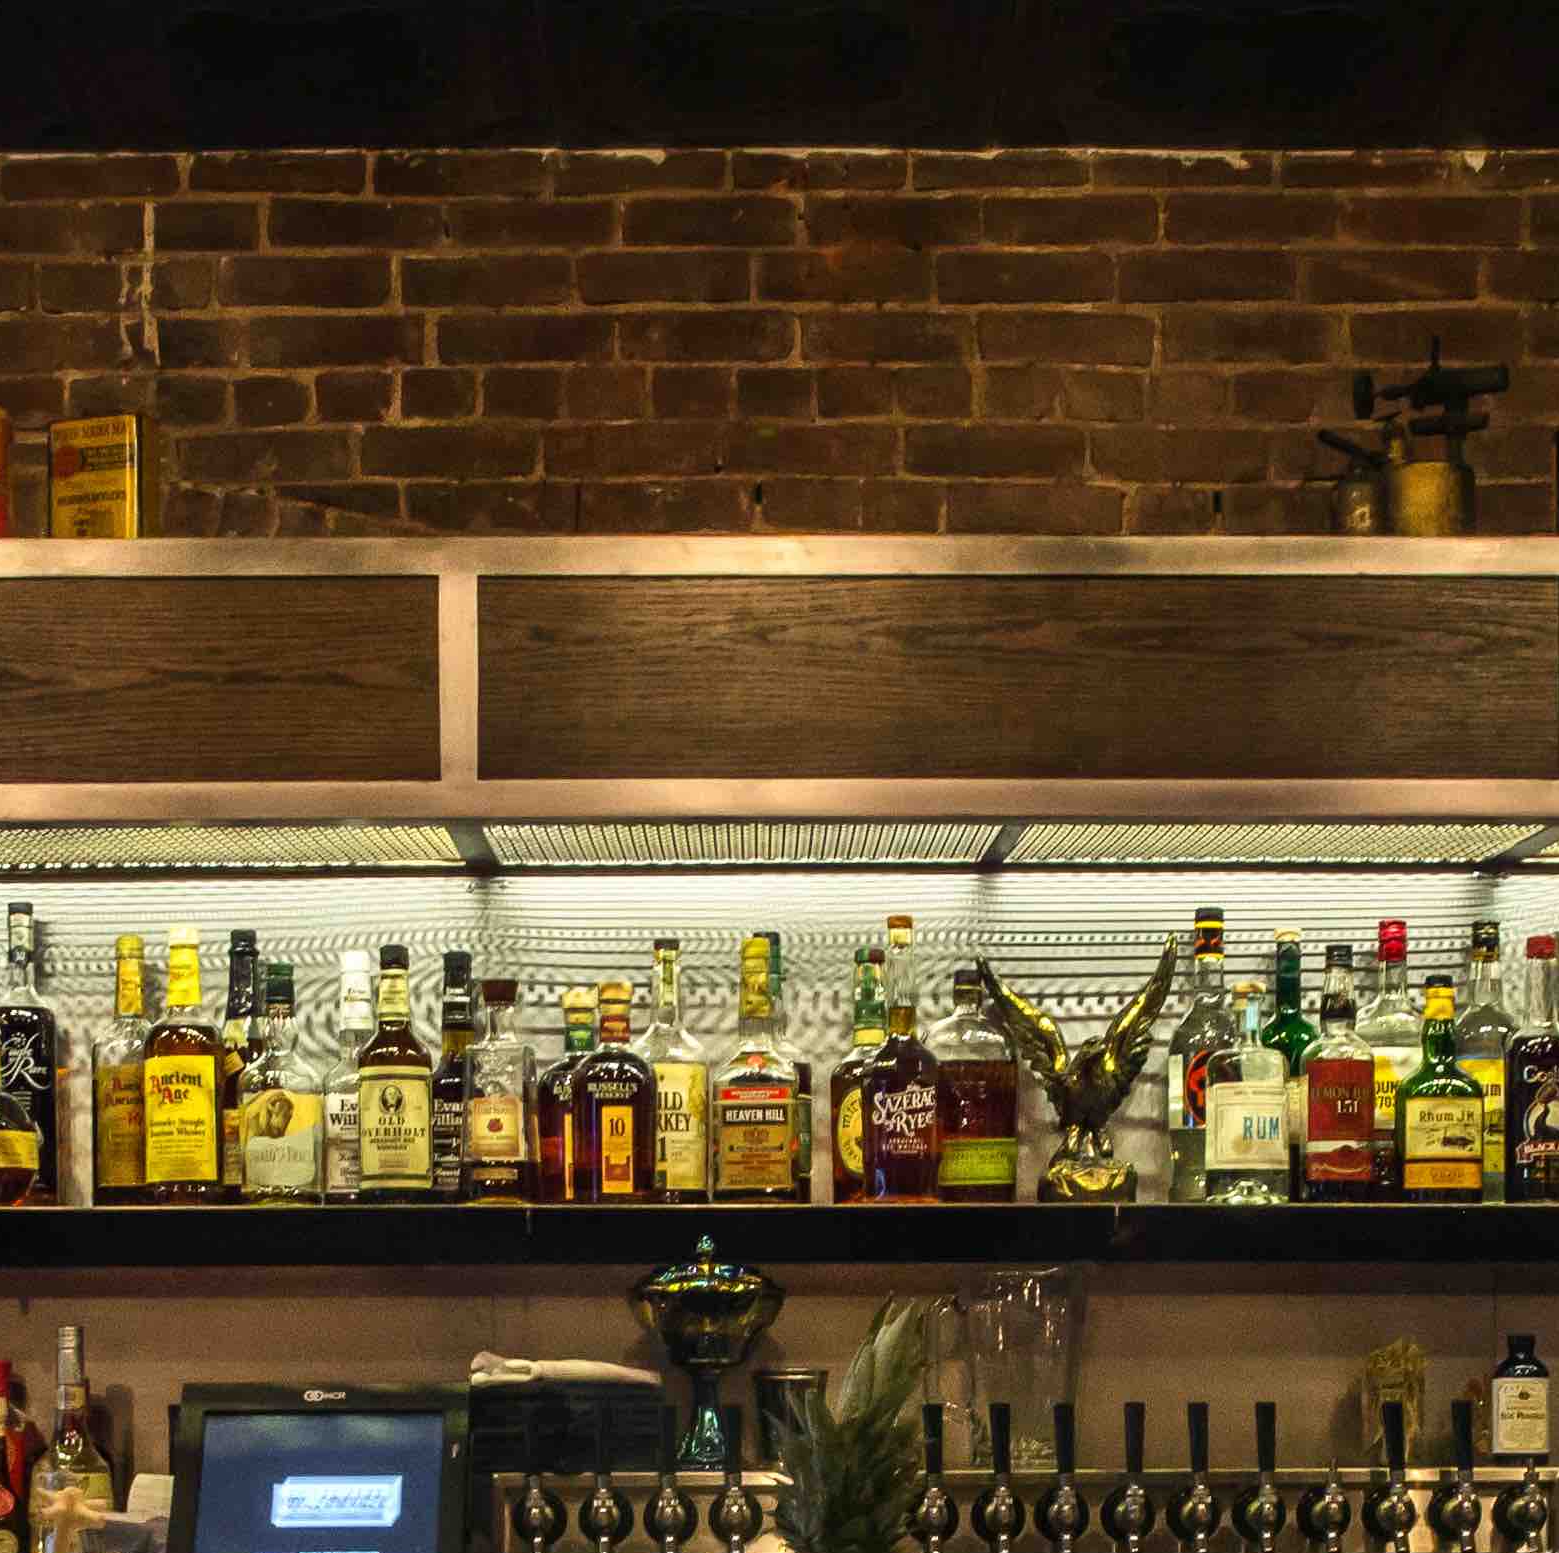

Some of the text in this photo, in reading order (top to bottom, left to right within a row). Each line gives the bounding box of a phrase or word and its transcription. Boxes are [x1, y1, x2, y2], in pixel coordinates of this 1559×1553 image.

[658, 1091, 683, 1110] ILD
[872, 1086, 937, 1125] SAZERAC
[330, 1113, 357, 1126] Will
[378, 1116, 406, 1125] OLD
[726, 1108, 785, 1121] HEAVEN HILL
[1419, 1110, 1454, 1122] Rhum
[609, 1118, 626, 1137] 10
[1243, 1116, 1280, 1140] RUM
